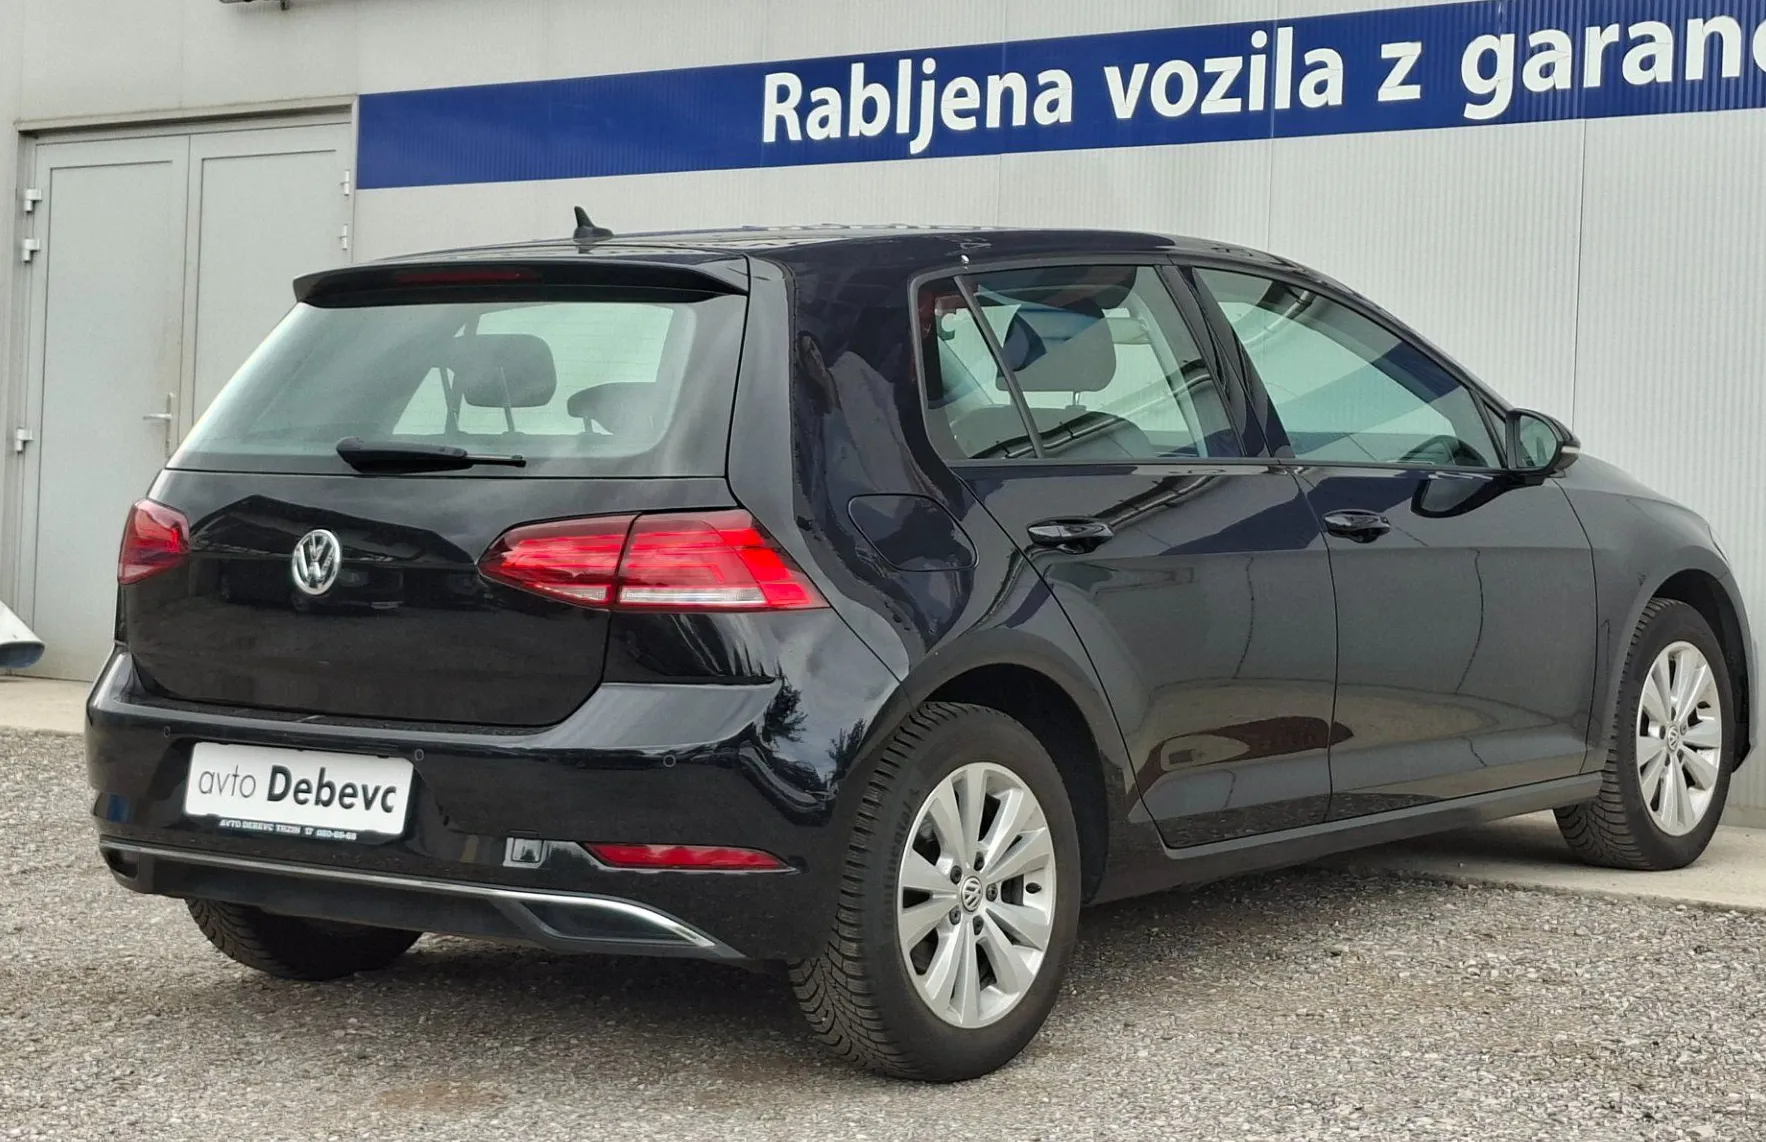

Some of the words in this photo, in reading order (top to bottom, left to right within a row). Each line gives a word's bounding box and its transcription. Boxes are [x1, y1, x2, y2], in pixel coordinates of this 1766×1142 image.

[763, 57, 1073, 154] Rabljena
[1103, 26, 1344, 119] vozila
[1377, 41, 1422, 102] z
[292, 529, 340, 595] VW
[198, 764, 257, 798] avto
[266, 764, 397, 814] Debevc
